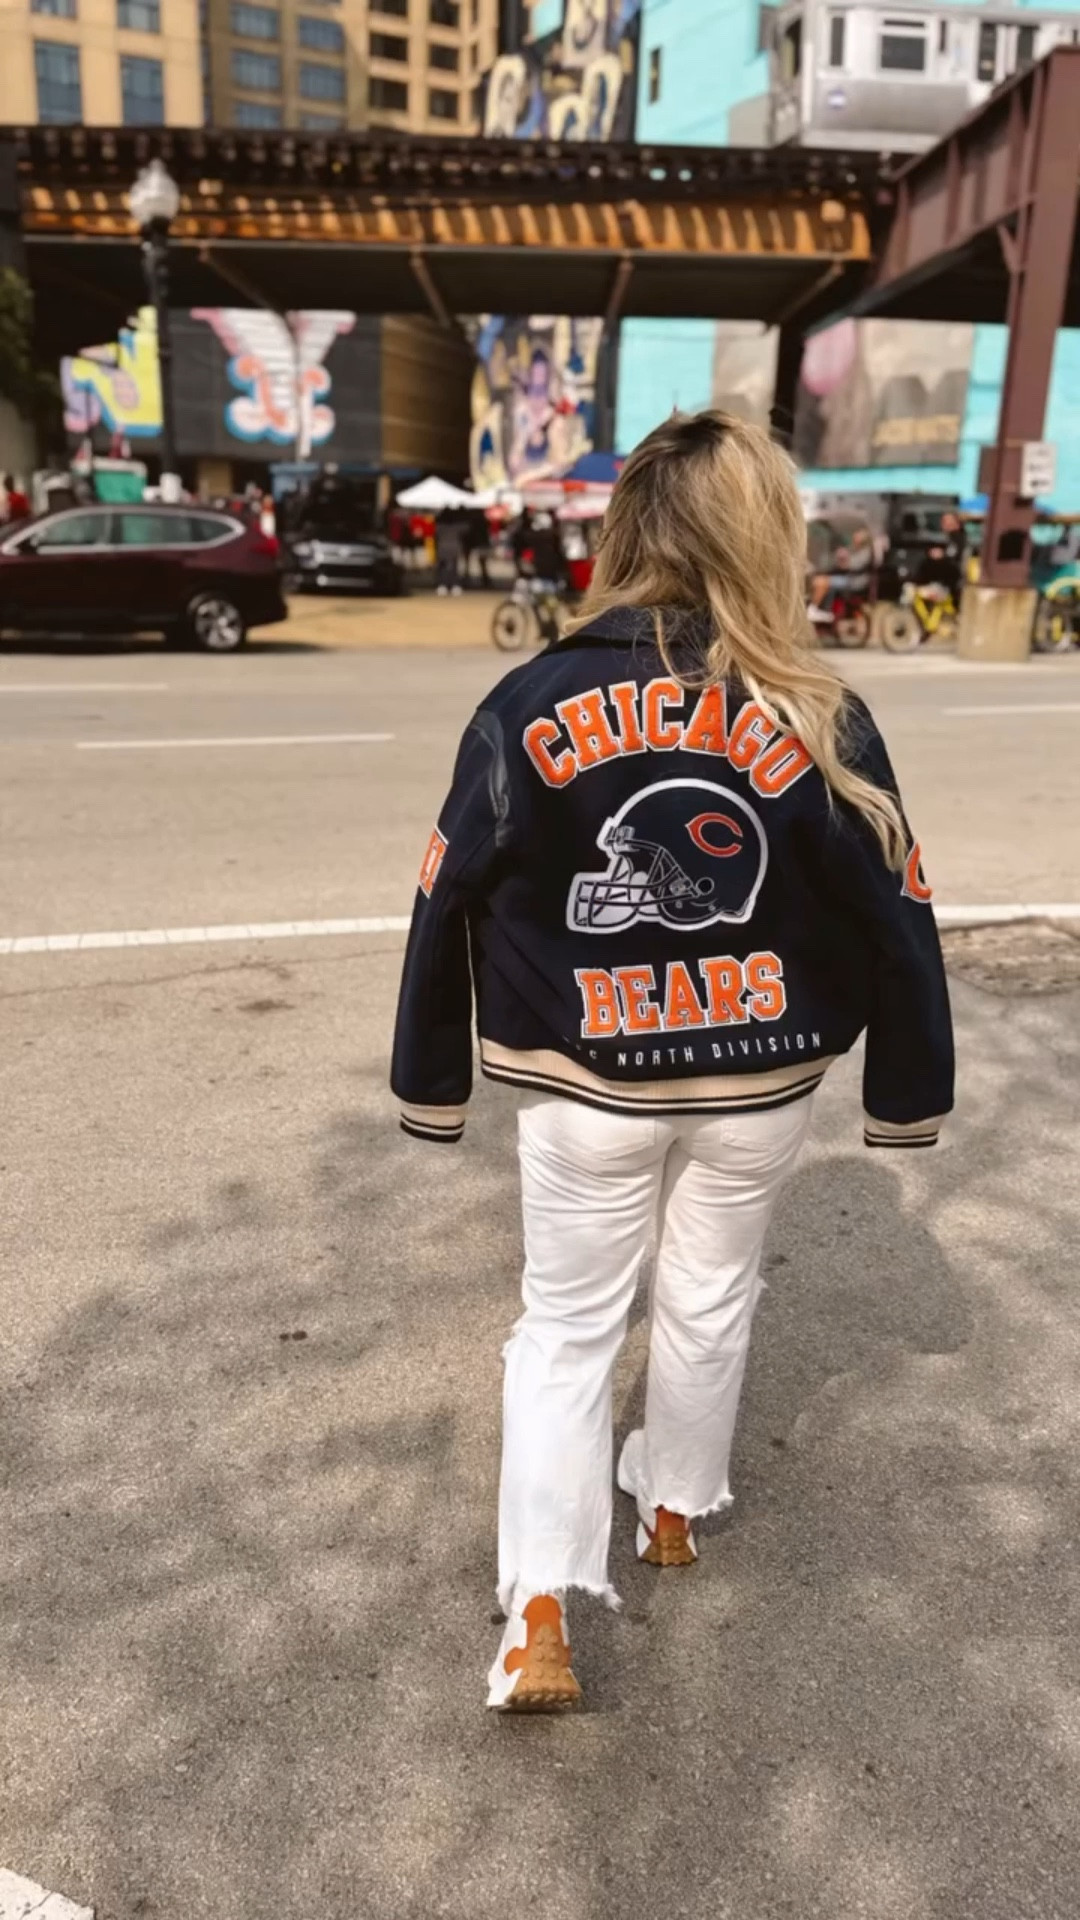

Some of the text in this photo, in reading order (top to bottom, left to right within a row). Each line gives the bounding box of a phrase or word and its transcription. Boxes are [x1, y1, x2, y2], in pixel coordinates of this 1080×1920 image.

[522, 677, 816, 798] CHICAGO
[684, 812, 743, 858] C
[573, 951, 787, 1038] BEARS
[617, 1047, 694, 1067] NORTH
[711, 1032, 822, 1058] DIVISION
